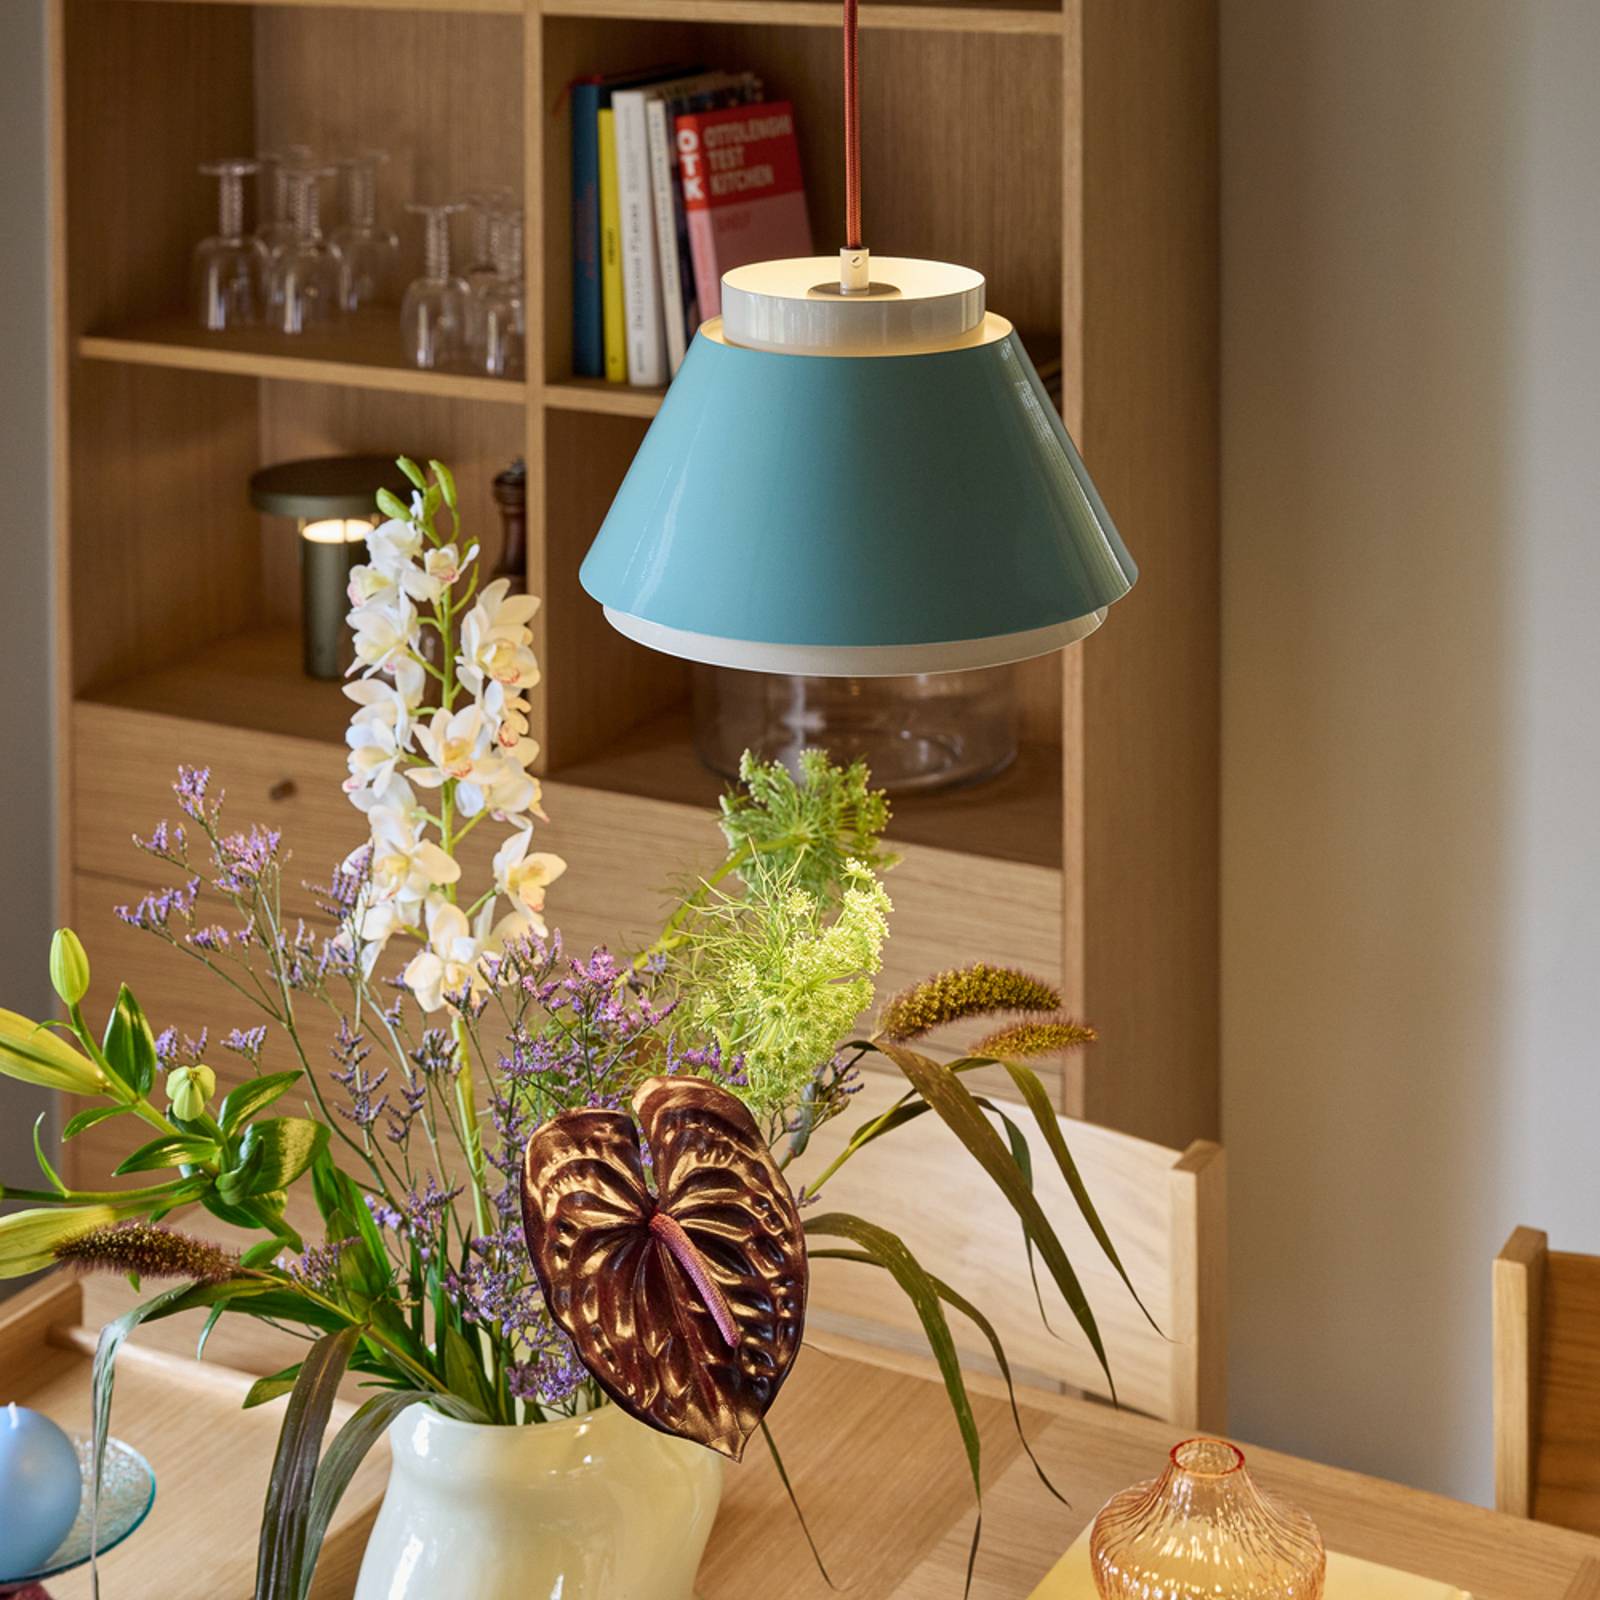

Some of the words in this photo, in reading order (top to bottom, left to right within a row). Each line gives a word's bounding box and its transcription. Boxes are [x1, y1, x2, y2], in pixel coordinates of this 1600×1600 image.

[704, 114, 792, 148] OTTOLENGHI
[677, 129, 704, 200] OTK
[708, 145, 744, 171] TEST
[710, 165, 774, 196] KITCHEN
